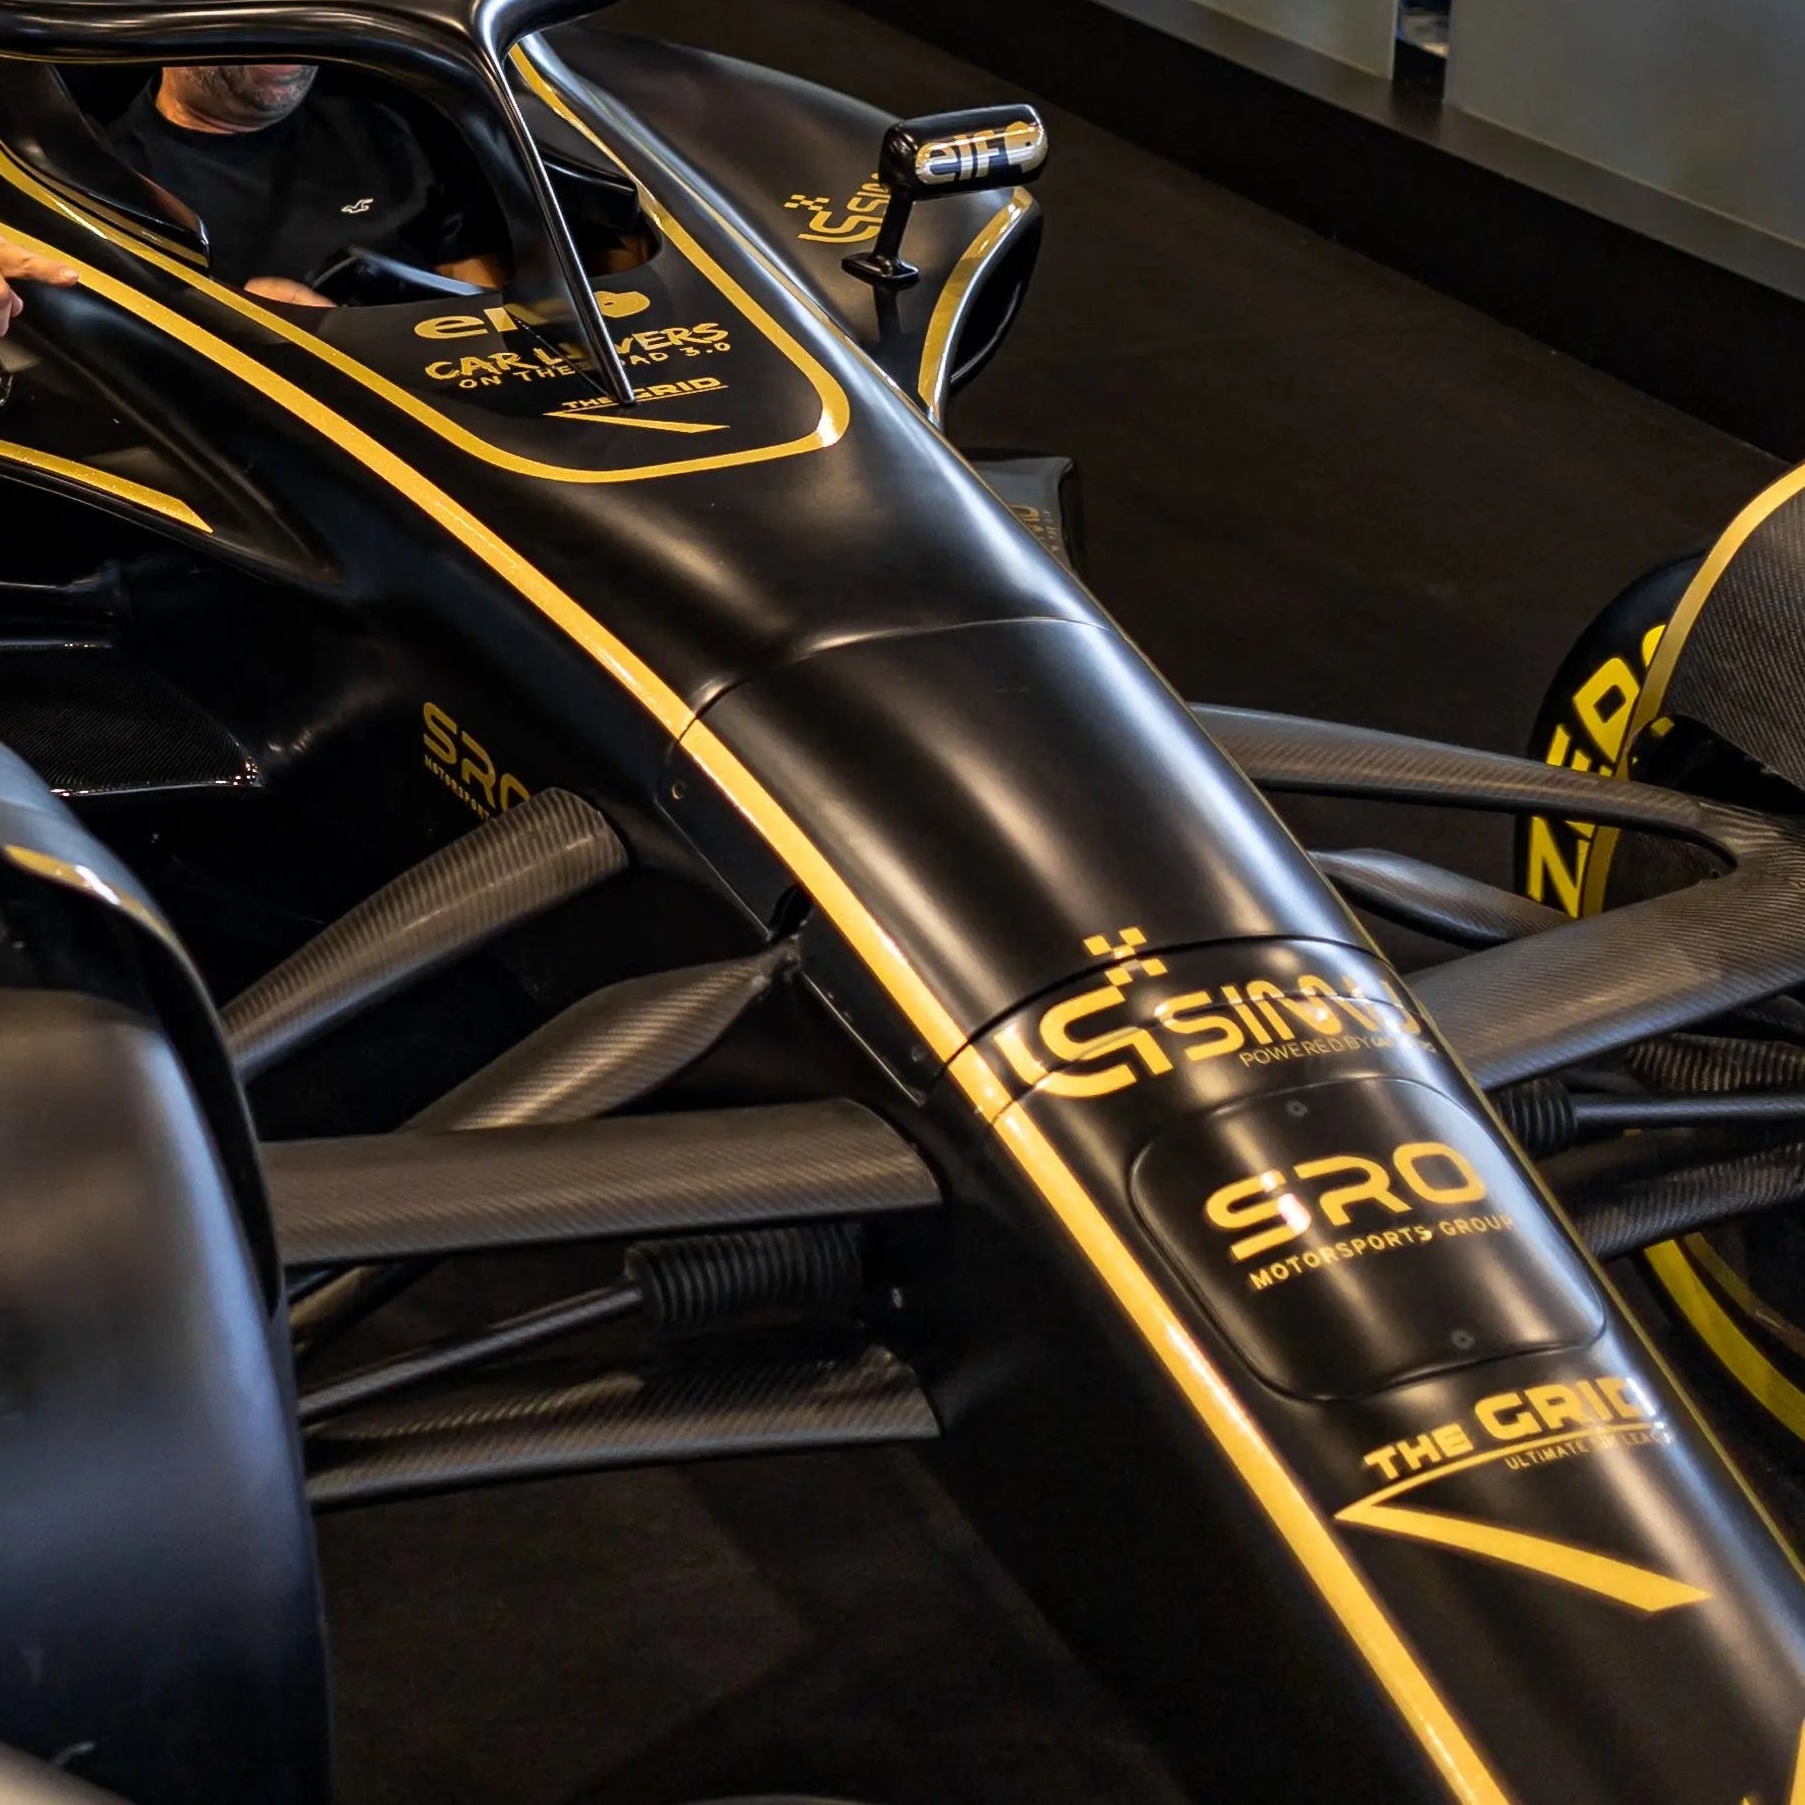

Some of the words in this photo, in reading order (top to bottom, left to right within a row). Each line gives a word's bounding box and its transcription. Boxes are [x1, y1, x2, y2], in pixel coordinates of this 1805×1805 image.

[915, 129, 1000, 185] elf
[424, 351, 524, 381] CAR
[532, 322, 730, 370] LVERS
[459, 372, 501, 389] ON
[680, 341, 731, 358] 3.0
[1238, 1037, 1344, 1069] POWERED
[1346, 1035, 1371, 1050] BY
[1205, 1140, 1488, 1262] SRO
[1249, 1225, 1433, 1291] MOTORSPORTS
[1438, 1214, 1515, 1237] GROUP
[1362, 1422, 1475, 1481] THE
[1474, 1376, 1658, 1441] GRID
[1505, 1439, 1590, 1471] ULTIMATE
